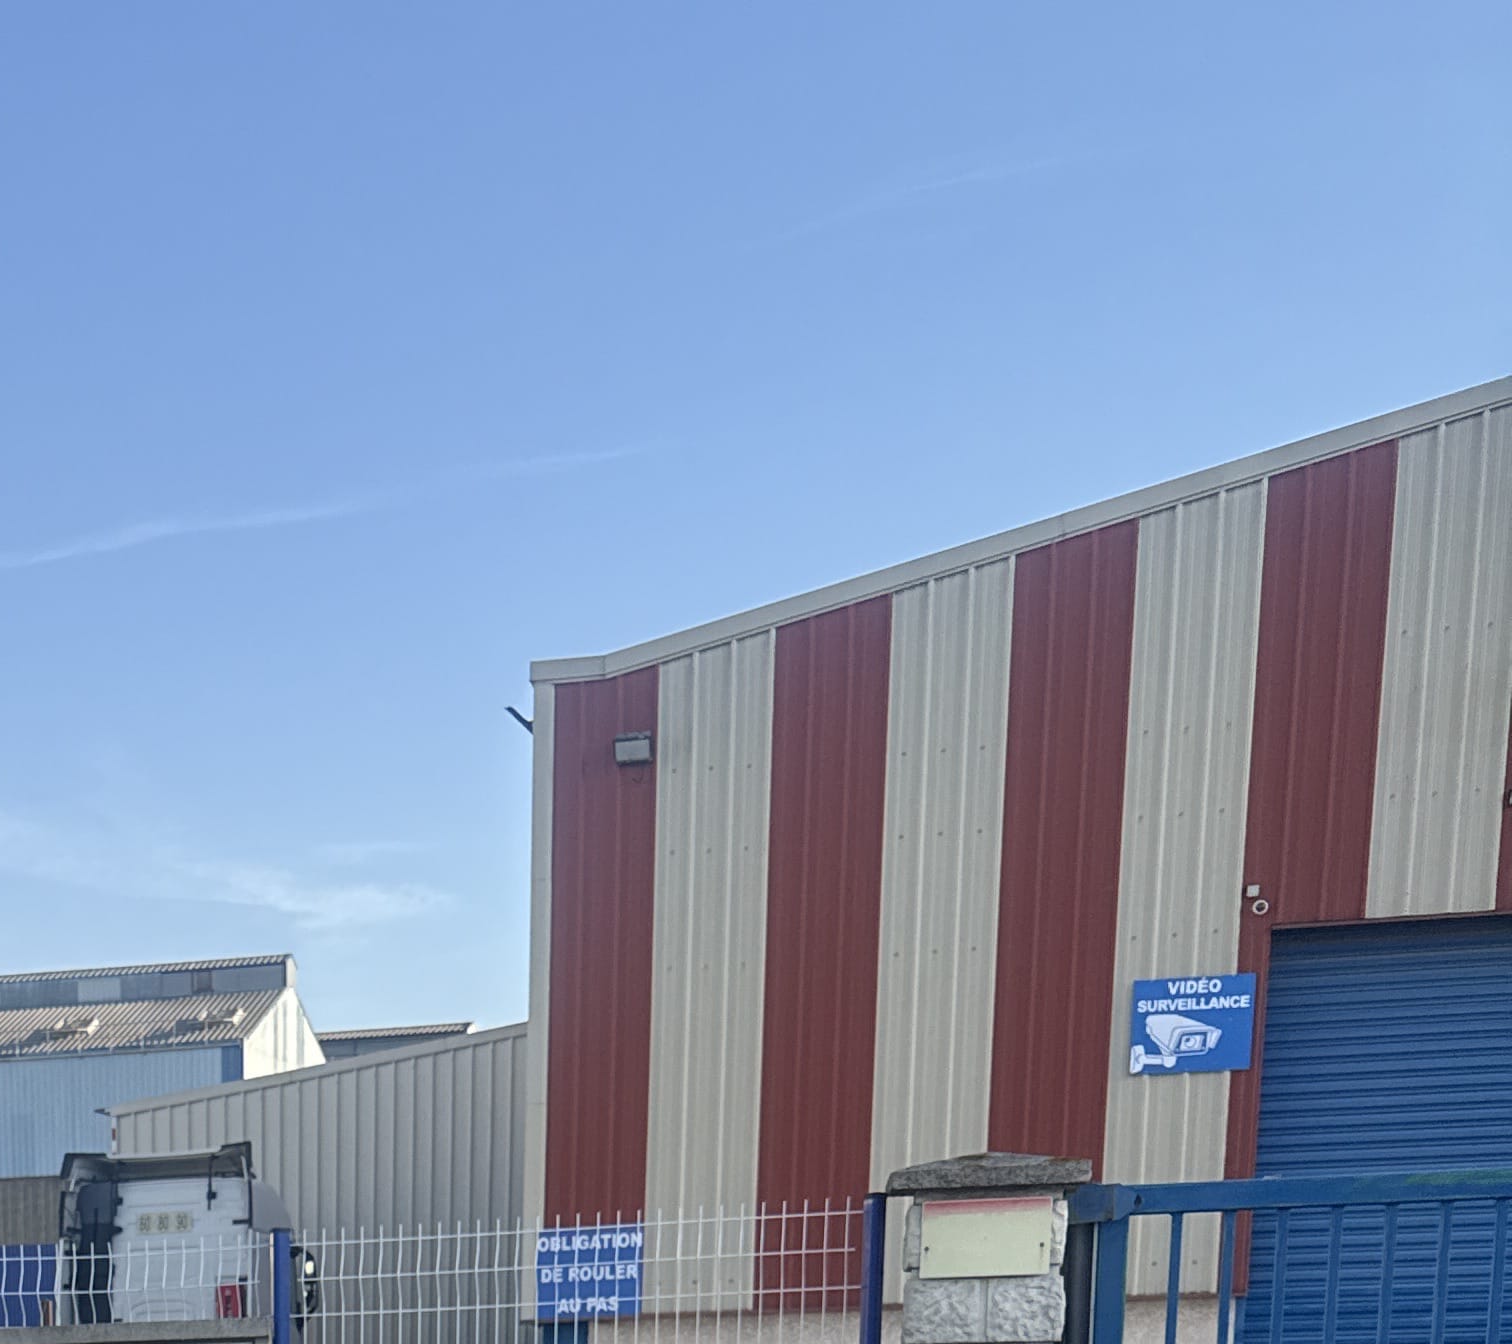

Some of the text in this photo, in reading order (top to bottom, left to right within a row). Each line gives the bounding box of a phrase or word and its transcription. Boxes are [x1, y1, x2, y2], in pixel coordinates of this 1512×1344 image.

[1168, 977, 1222, 995] VIDÉO
[1137, 995, 1251, 1013] SURVEILLANCE
[537, 1232, 643, 1252] OBLIGATION
[541, 1264, 638, 1283] DE ROULER
[557, 1296, 618, 1314] AU PAS
